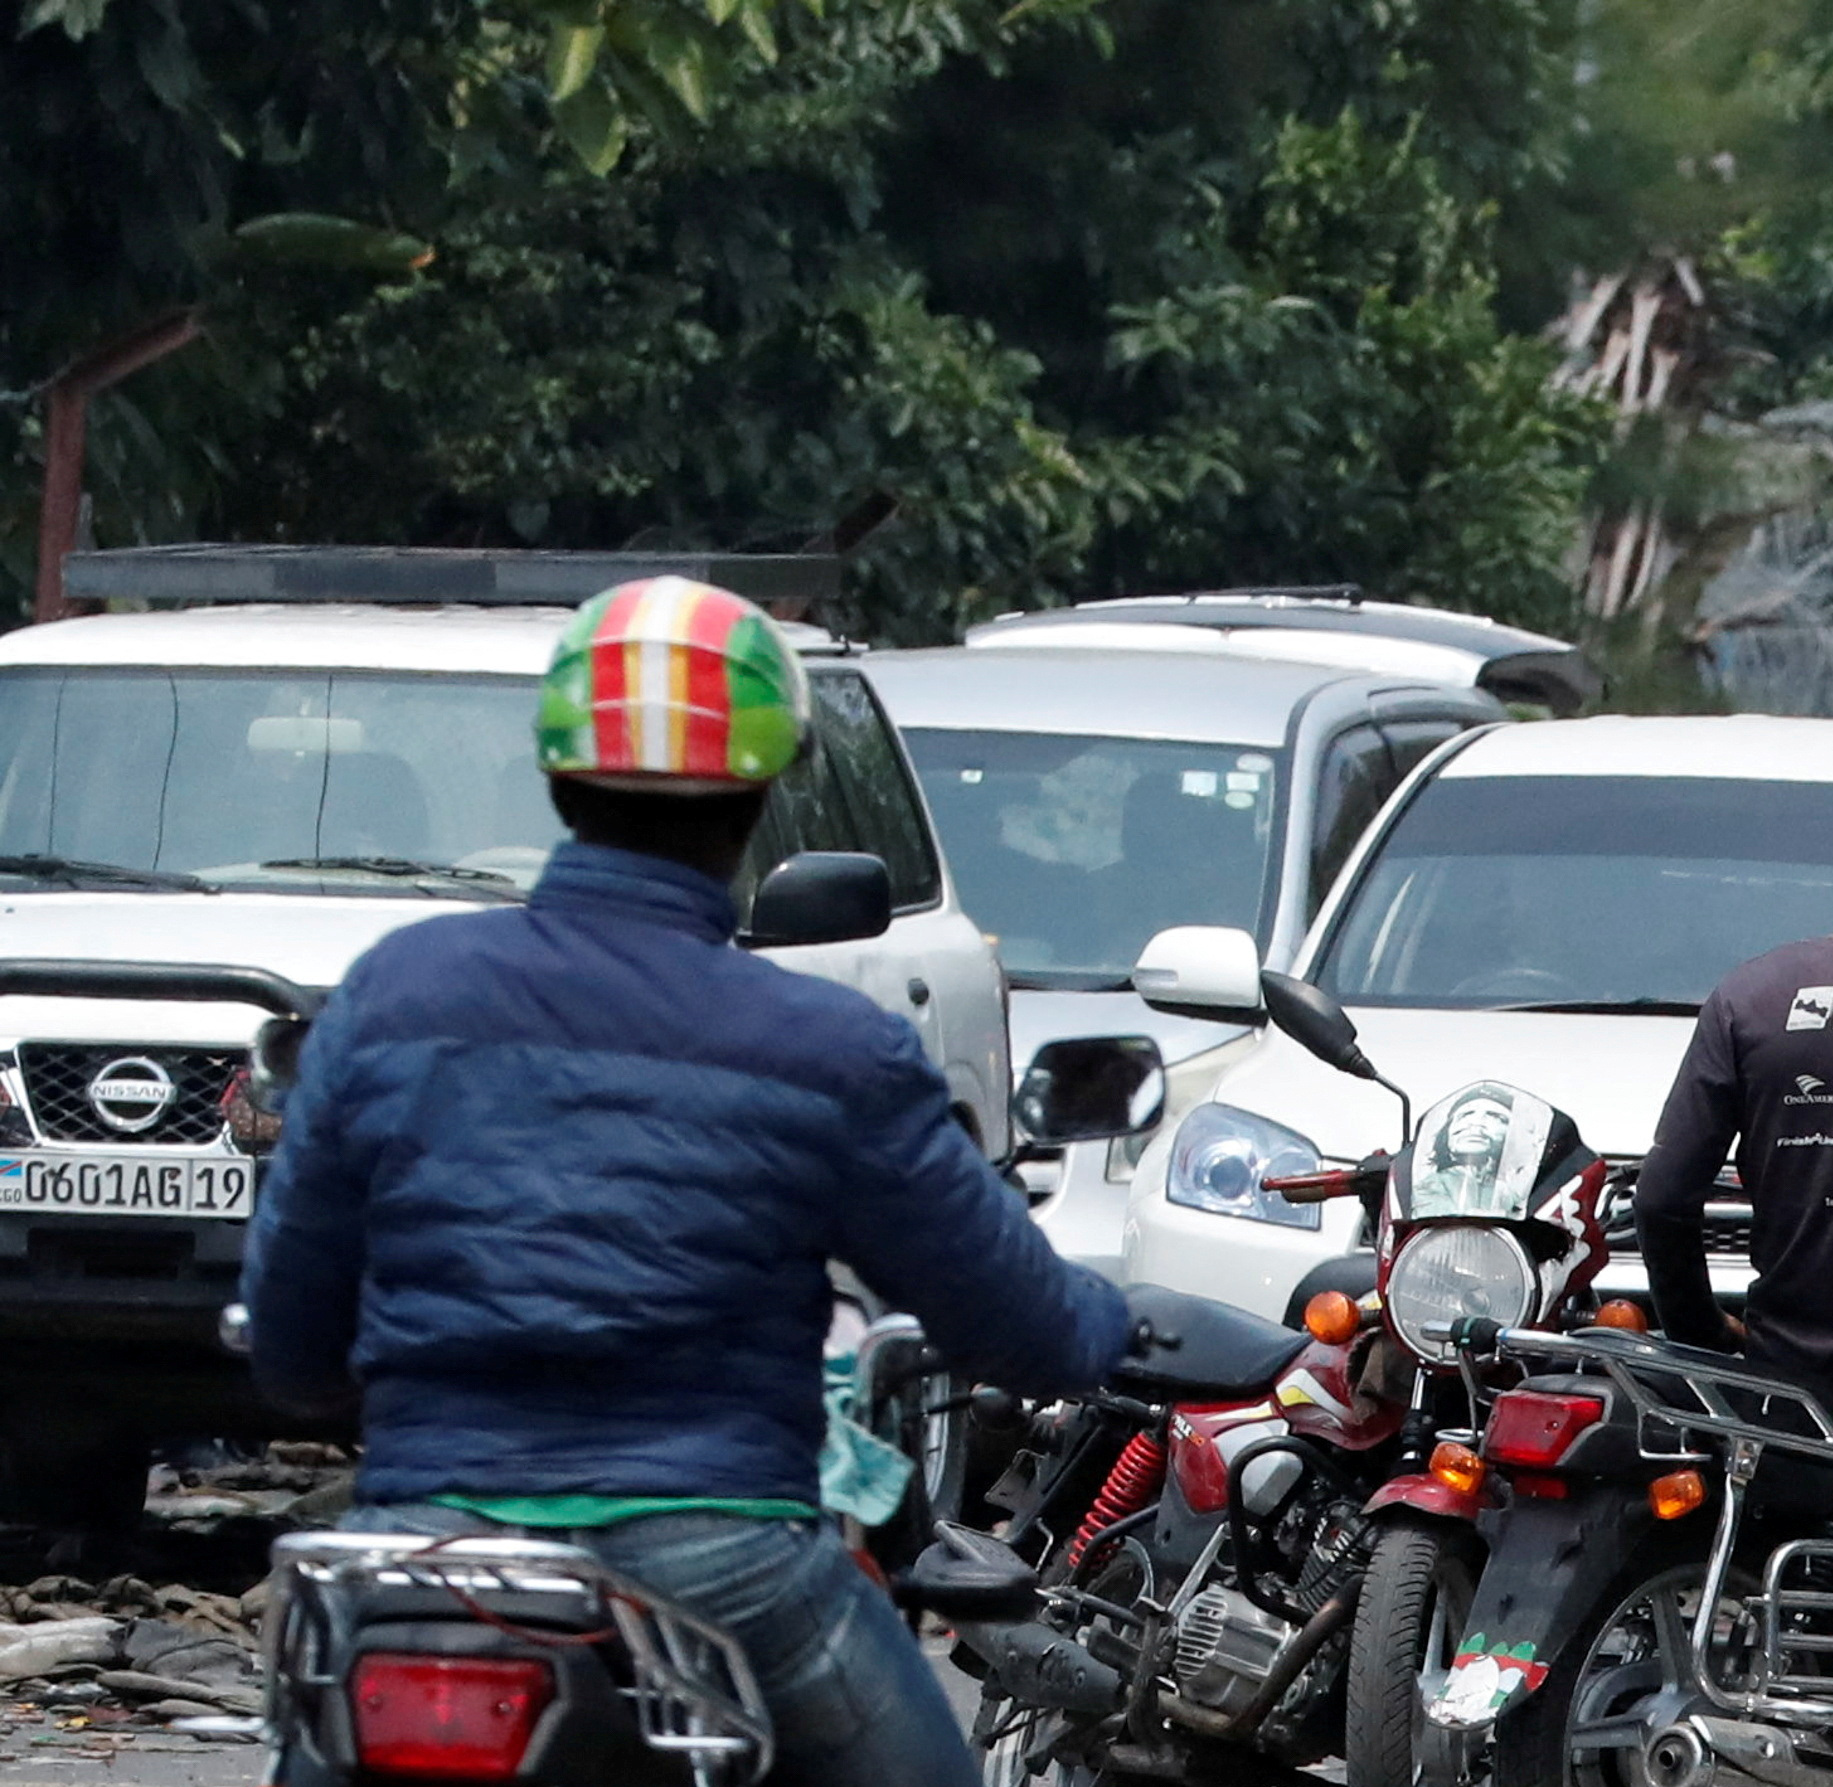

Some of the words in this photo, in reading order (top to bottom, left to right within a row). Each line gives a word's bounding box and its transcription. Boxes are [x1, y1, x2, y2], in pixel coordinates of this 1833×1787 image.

[92, 1084, 167, 1099] NISSAN
[26, 1160, 183, 1208] 0601AG
[195, 1167, 246, 1210] 19
